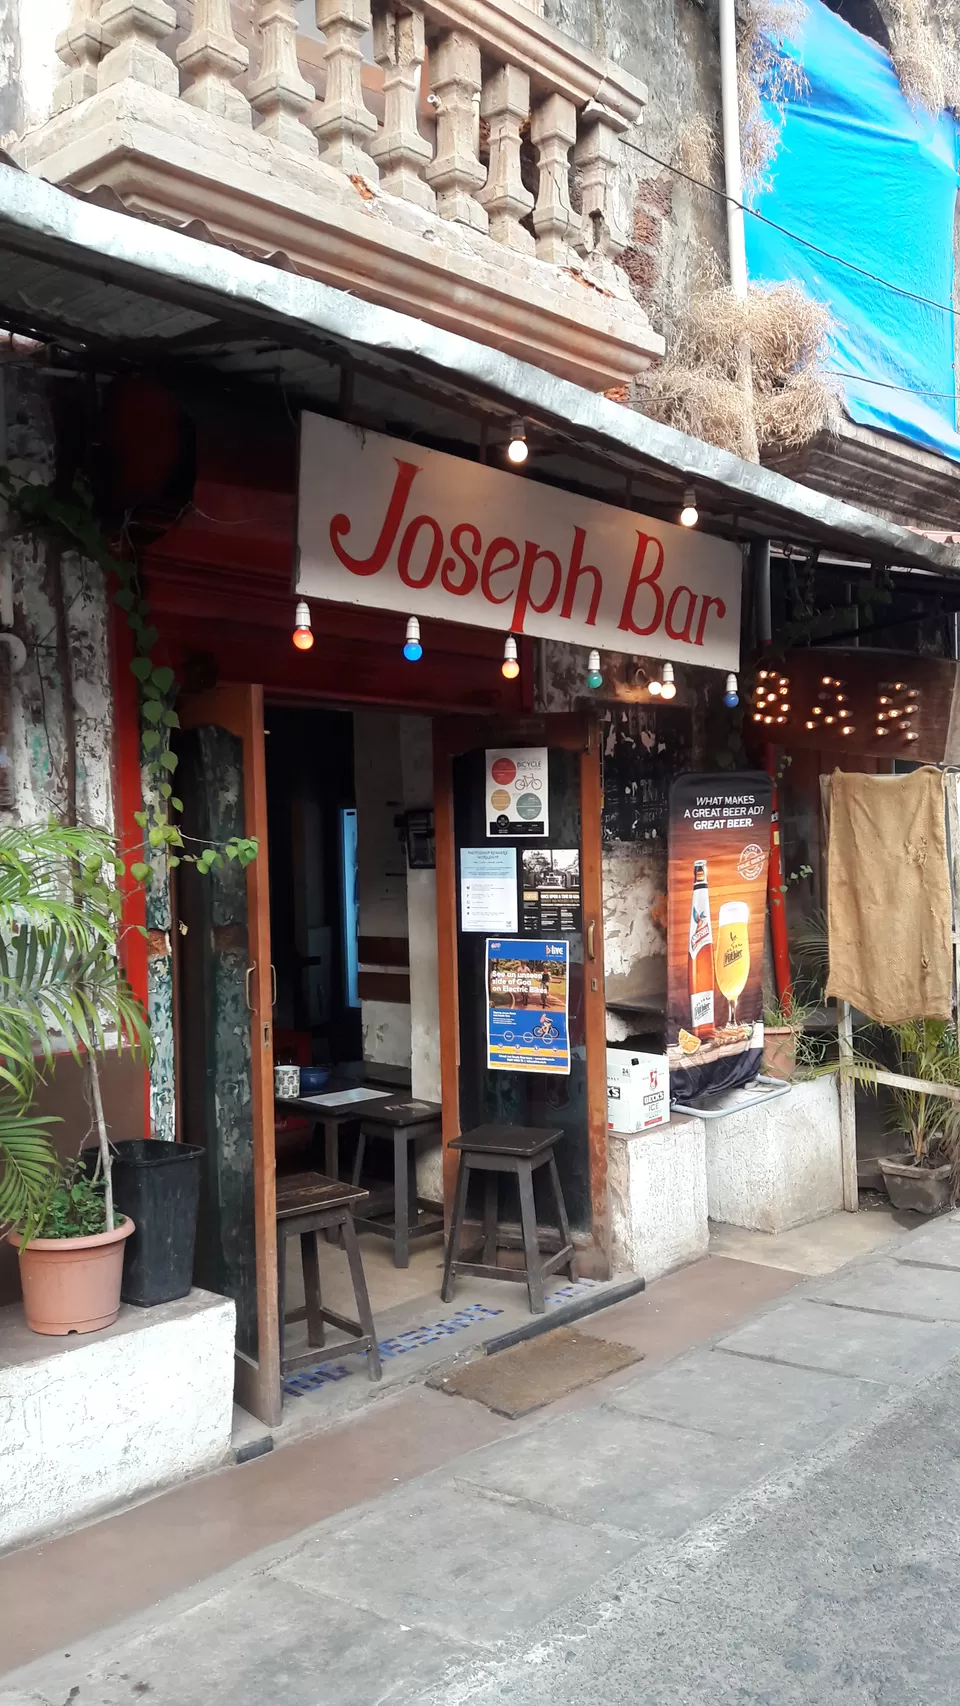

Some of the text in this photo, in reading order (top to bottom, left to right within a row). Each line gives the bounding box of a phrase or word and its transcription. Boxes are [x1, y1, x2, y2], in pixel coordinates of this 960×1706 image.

[330, 457, 726, 647] Joseph Bar
[753, 670, 920, 741] BAR
[517, 760, 542, 768] BICYCLE
[696, 795, 755, 806] WHAT MAKES
[683, 805, 765, 818] A GREAT BEER AD?
[693, 818, 754, 830] GREAT BEER.
[502, 985, 529, 993] Electric
[529, 986, 548, 994] Bikes
[648, 1102, 660, 1111] ICE
